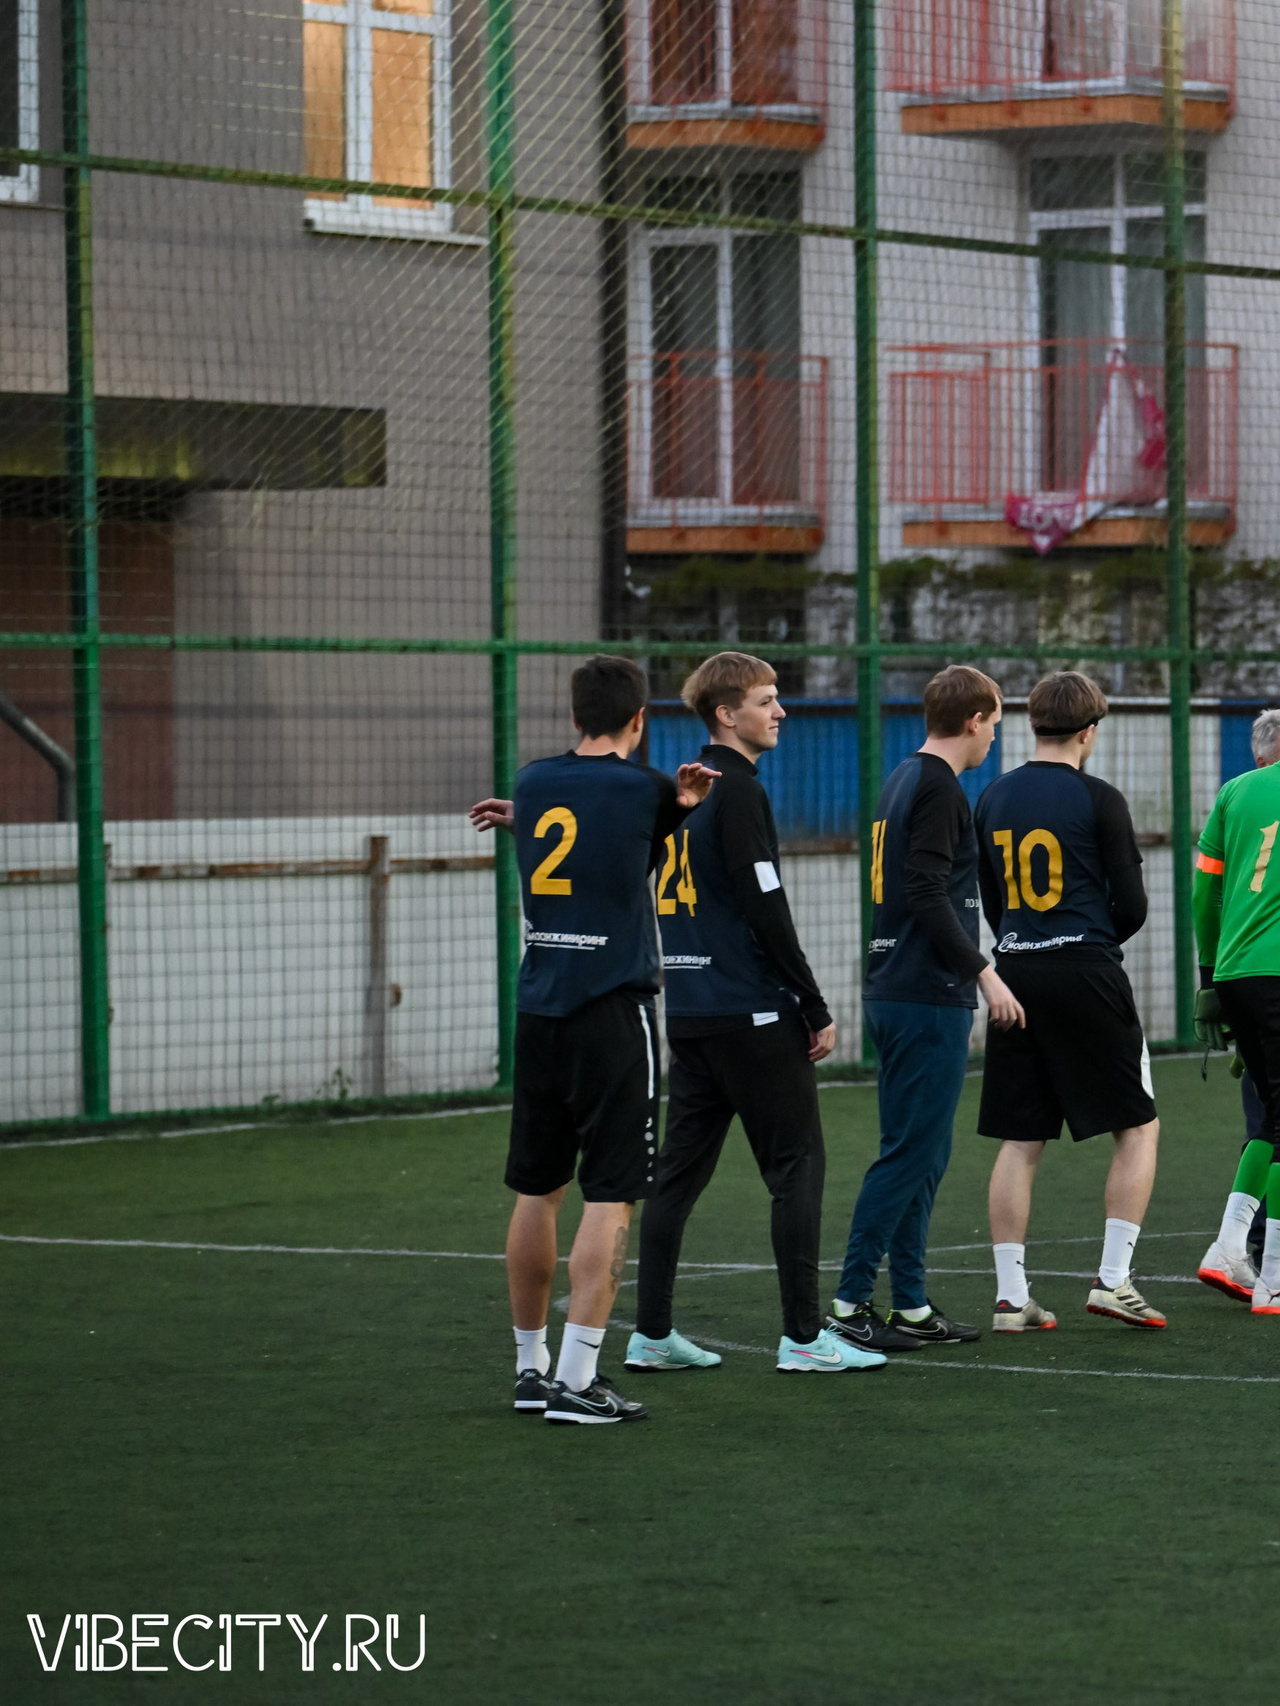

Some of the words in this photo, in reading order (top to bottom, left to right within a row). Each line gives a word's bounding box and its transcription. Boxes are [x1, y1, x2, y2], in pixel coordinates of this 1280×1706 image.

[530, 806, 578, 896] 2
[657, 829, 697, 917] 24
[992, 828, 1064, 912] 10
[1248, 820, 1280, 893] 1
